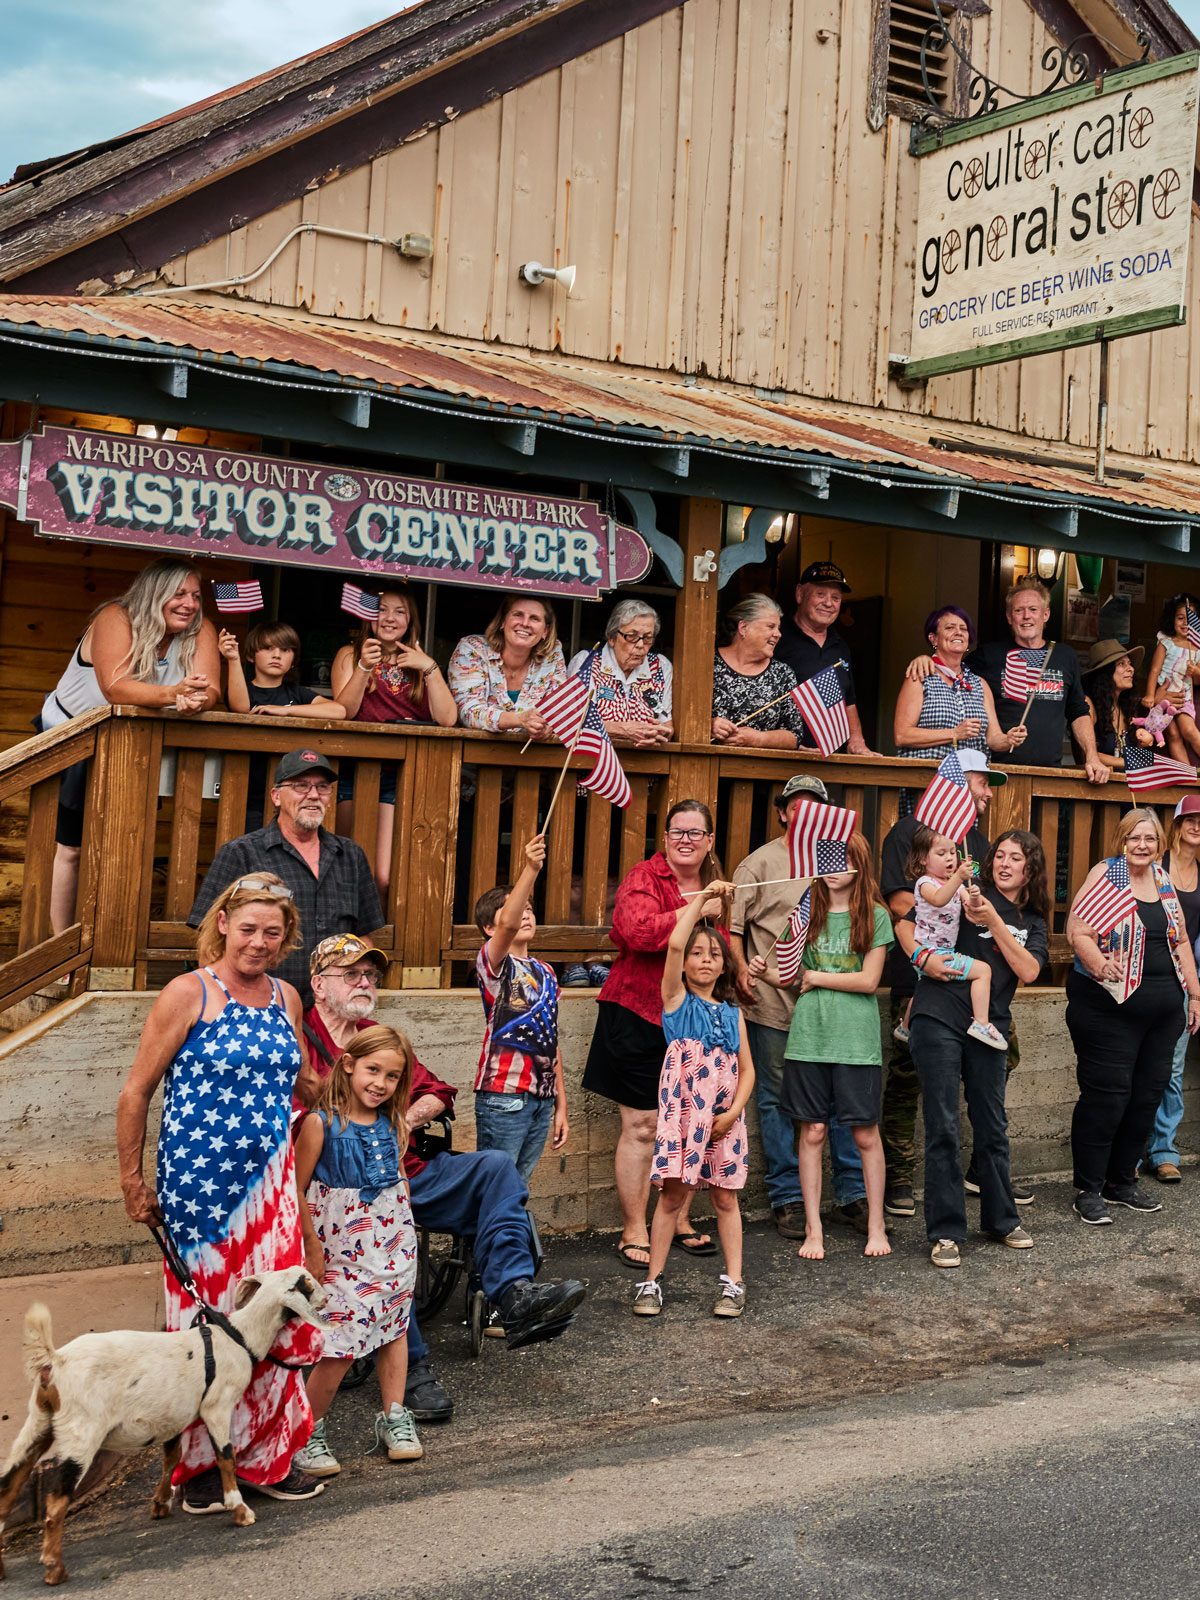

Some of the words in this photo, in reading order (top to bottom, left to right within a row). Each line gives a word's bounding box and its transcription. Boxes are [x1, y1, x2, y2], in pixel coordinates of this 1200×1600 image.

[1074, 92, 1153, 164] cafe
[921, 186, 1059, 298] general
[1070, 168, 1181, 242] store
[919, 295, 987, 329] GROCERY
[991, 287, 1016, 311] ICE
[1021, 274, 1064, 304] BEER
[1068, 261, 1113, 292] WINE
[1119, 248, 1172, 279] SODA
[972, 326, 993, 338] FULL
[995, 314, 1034, 333] SERVICE
[1036, 301, 1099, 324] RESTAURANT
[66, 434, 209, 476] MARIPOSA
[214, 457, 321, 491] COUNTY
[54, 461, 338, 550] VISITOR
[351, 502, 603, 581] CENTER
[363, 477, 480, 513] YOSEMITE
[536, 501, 589, 528] PARK
